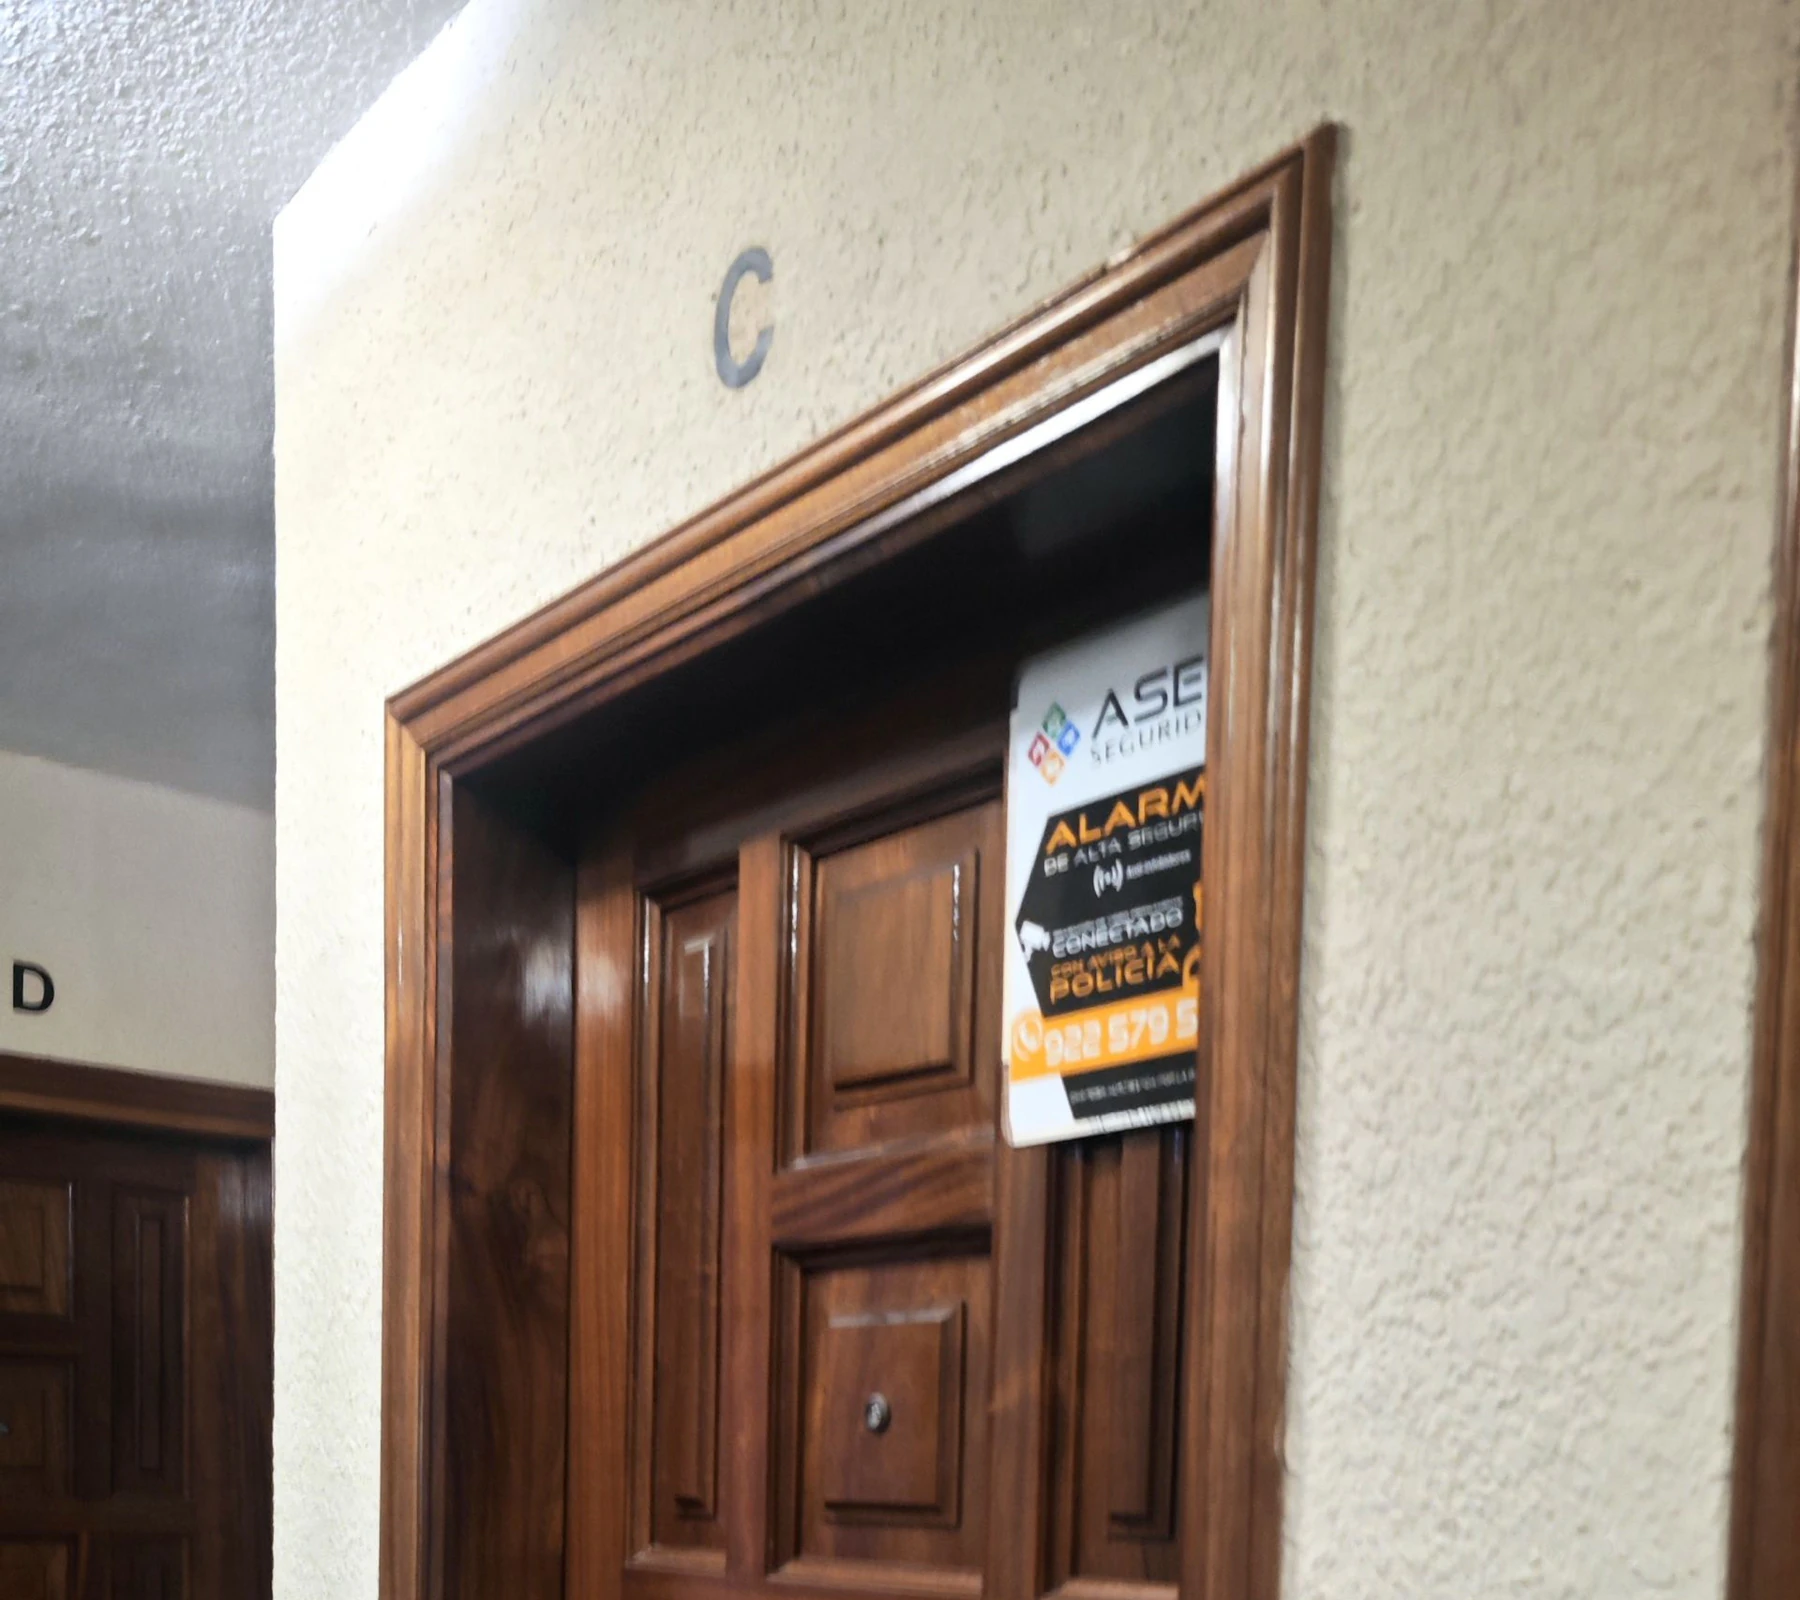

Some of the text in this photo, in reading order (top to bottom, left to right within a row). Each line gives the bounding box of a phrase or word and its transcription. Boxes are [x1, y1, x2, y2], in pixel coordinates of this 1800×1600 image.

[714, 246, 774, 389] C
[1091, 653, 1204, 740] ASE
[1046, 773, 1206, 856] ALARM
[1043, 851, 1069, 877] DE
[1073, 837, 1122, 867] ALTA
[1052, 907, 1184, 958] CONECTADO
[13, 959, 55, 1014] D
